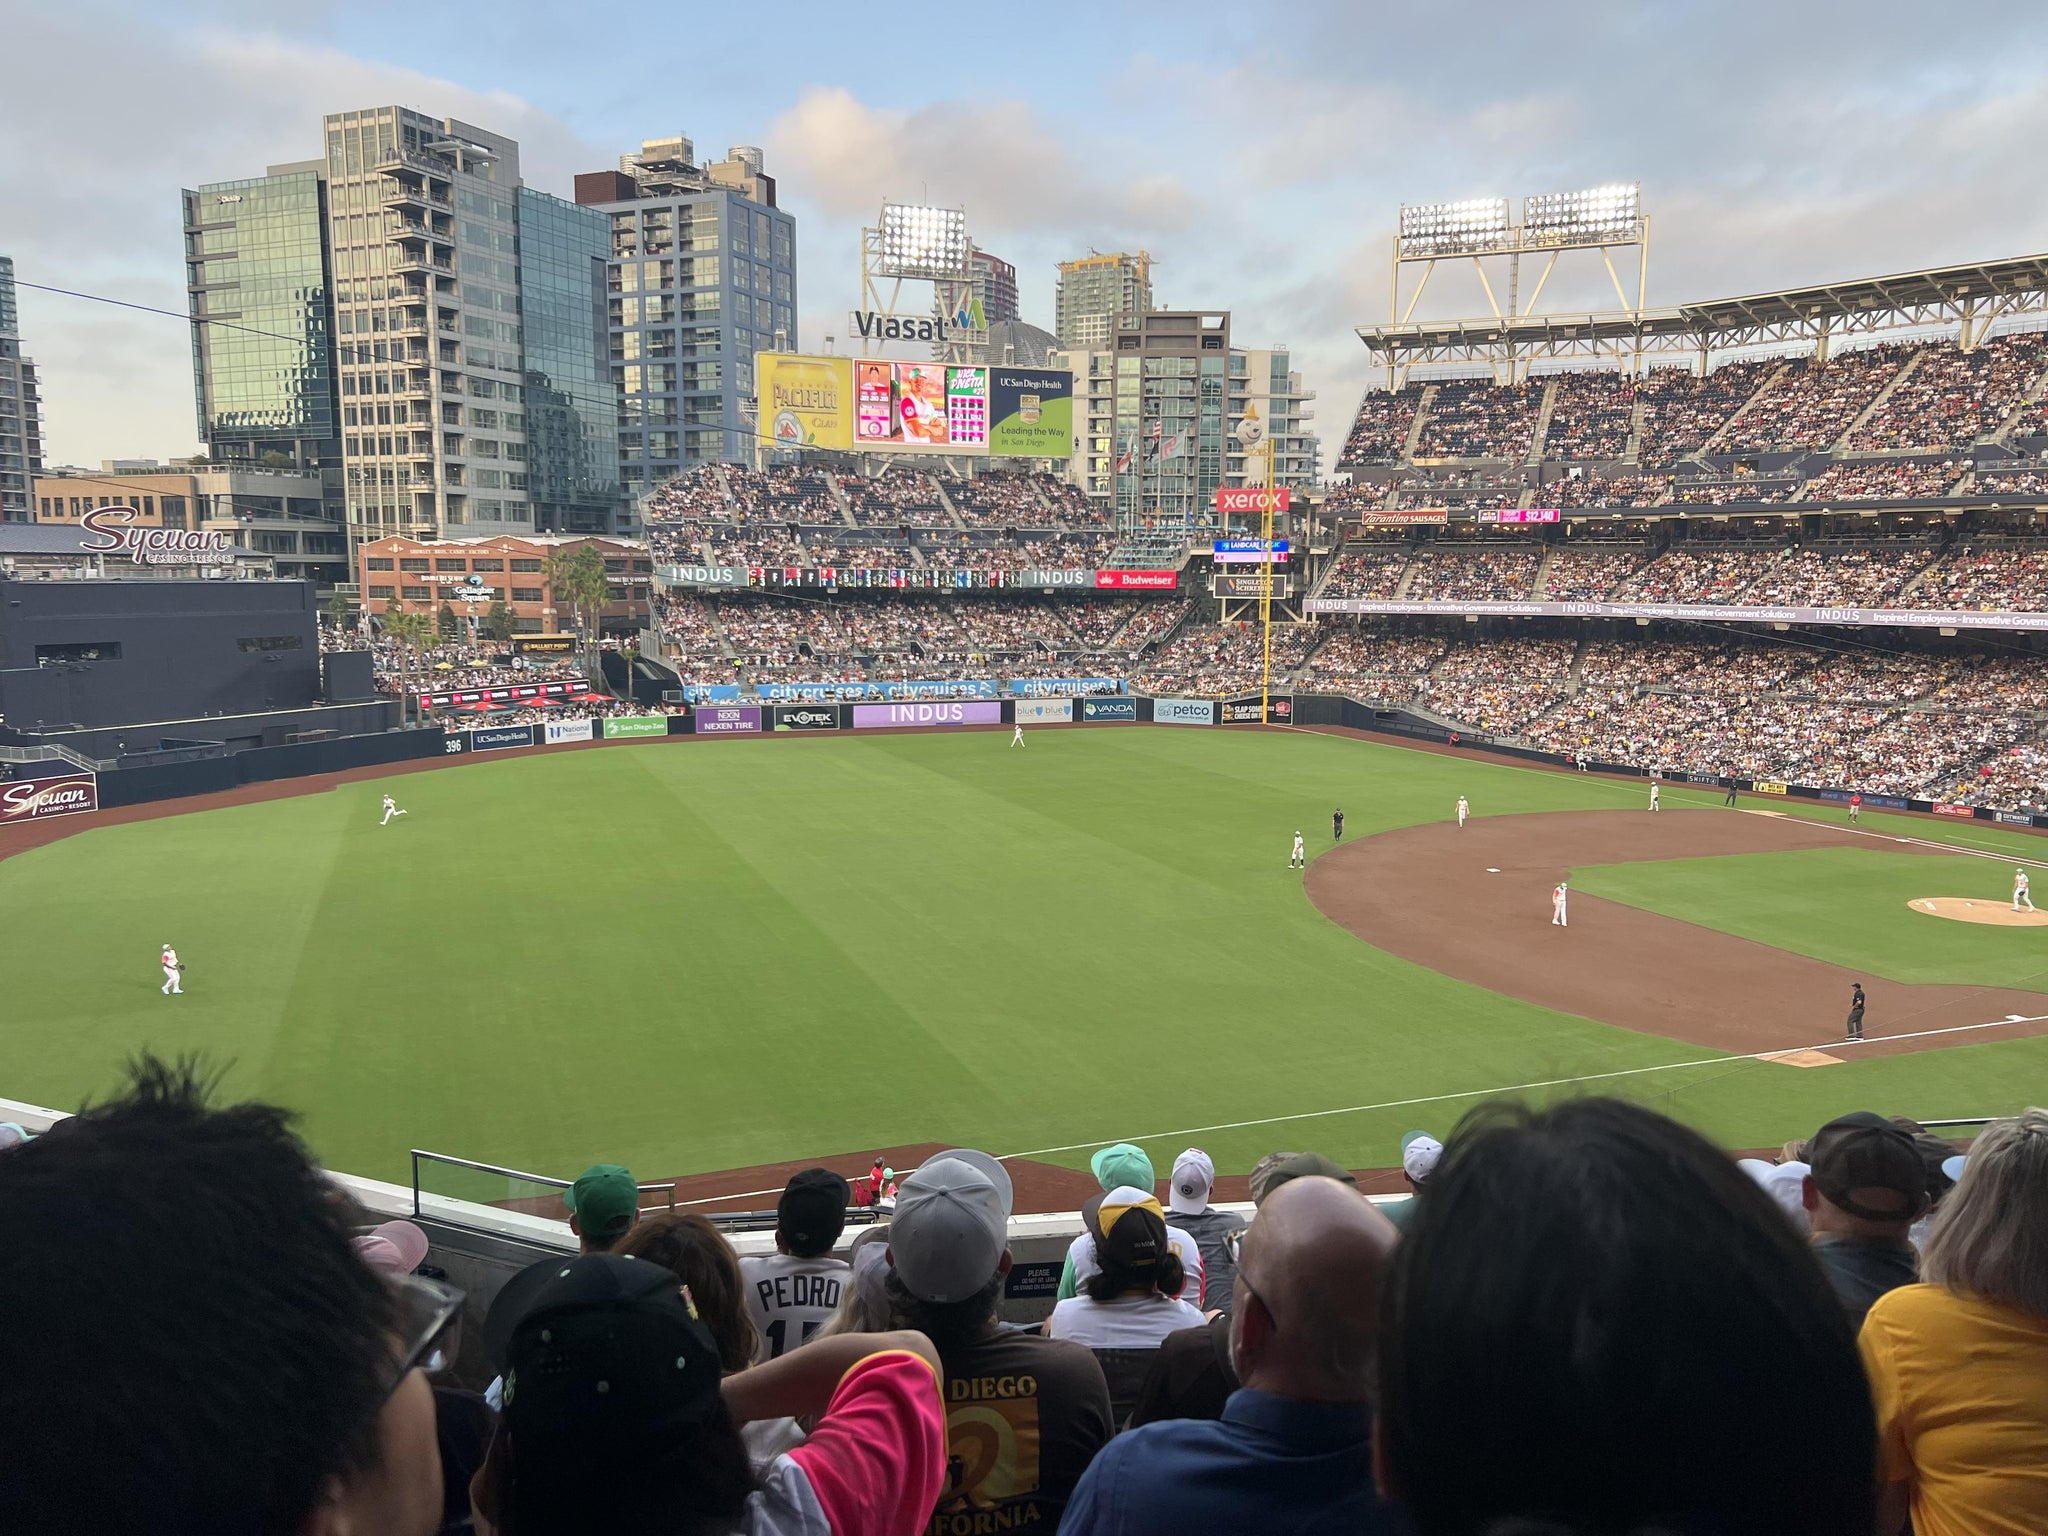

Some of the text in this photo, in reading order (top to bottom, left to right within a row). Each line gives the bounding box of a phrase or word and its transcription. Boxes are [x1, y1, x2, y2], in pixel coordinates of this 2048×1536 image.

[855, 311, 948, 341] Viasat
[1000, 378, 1062, 389] UC San Diego Health
[1002, 427, 1032, 436] Leading
[1049, 428, 1064, 437] Way
[1026, 439, 1045, 447] Diego
[1224, 492, 1282, 508] xerox
[1365, 513, 1408, 523] Tarantino
[80, 506, 229, 564] Sycuan
[147, 554, 235, 563] CASINO RESORT
[672, 568, 733, 582] INDUS
[760, 569, 765, 577] 2
[844, 574, 849, 583] 5
[866, 570, 871, 578] 2
[879, 574, 882, 582] 7
[1034, 572, 1084, 584] INDUS
[760, 578, 765, 586] 3
[866, 579, 871, 587] 3
[1122, 575, 1172, 585] Budweiser
[455, 586, 495, 595] Gallagher
[460, 594, 490, 603] Square
[1313, 601, 1348, 610] INDUS
[1359, 603, 1386, 612] Inspired
[1387, 604, 1423, 612] Employees
[1464, 604, 1508, 612] Government
[1509, 604, 1542, 612] Solutions
[1563, 604, 1795, 618] INDUS Inspired Employees Innovative Government Solutions
[1816, 611, 1860, 620] INDUS
[1874, 613, 1908, 623] Inspired
[1909, 613, 1956, 624] Employees
[1963, 616, 2011, 625] Innovative
[688, 687, 711, 697] city
[770, 685, 862, 699] citycruises
[889, 682, 976, 696] citycruises
[1024, 681, 1106, 694] citycruises
[892, 704, 963, 721] INDUS
[1045, 706, 1063, 714] blue
[1174, 704, 1209, 716] petco
[784, 712, 831, 724] EVOTEK
[562, 725, 589, 733] National
[704, 722, 732, 730] NEXEN
[477, 736, 487, 744] UC
[496, 734, 512, 742] Diego
[512, 732, 528, 740] Health
[446, 740, 461, 752] 396
[1689, 776, 1710, 784] SHIFT
[3, 784, 87, 816] Sycuan
[40, 805, 64, 813] CASINO
[1028, 1269, 1050, 1277] PLEASE
[757, 1274, 840, 1312] PEDRO
[766, 1320, 823, 1360] 1
[952, 1376, 1037, 1400] DIEGO
